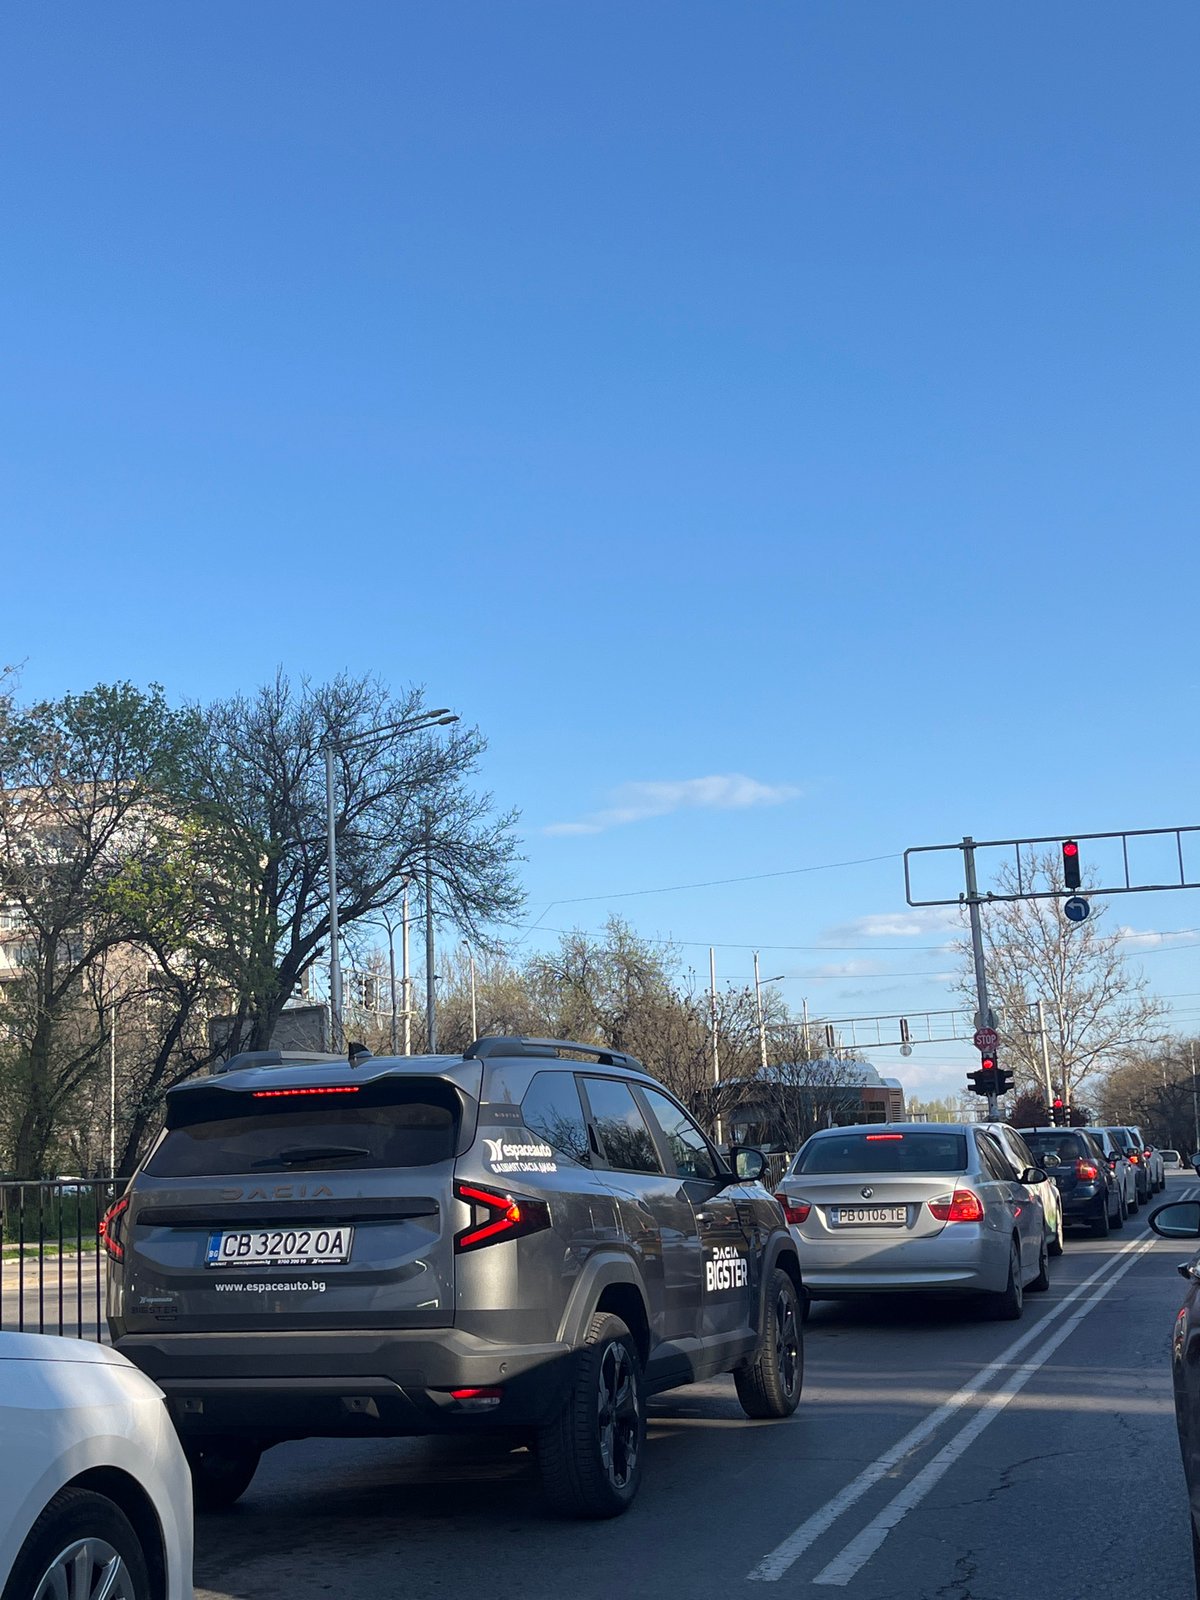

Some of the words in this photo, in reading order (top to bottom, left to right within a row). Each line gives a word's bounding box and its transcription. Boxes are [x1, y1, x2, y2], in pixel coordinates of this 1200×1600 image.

[976, 1034, 997, 1045] STOP
[502, 1143, 552, 1160] espaceauto
[222, 1184, 334, 1201] DACIA
[839, 1209, 856, 1222] PB
[857, 1208, 887, 1221] 0106
[223, 1234, 251, 1257] CB
[255, 1231, 312, 1256] 3202
[208, 1250, 219, 1258] BG
[712, 1246, 739, 1260] DACIA
[706, 1258, 748, 1292] BIGSTER
[215, 1280, 326, 1292] www.espaceauto.bg
